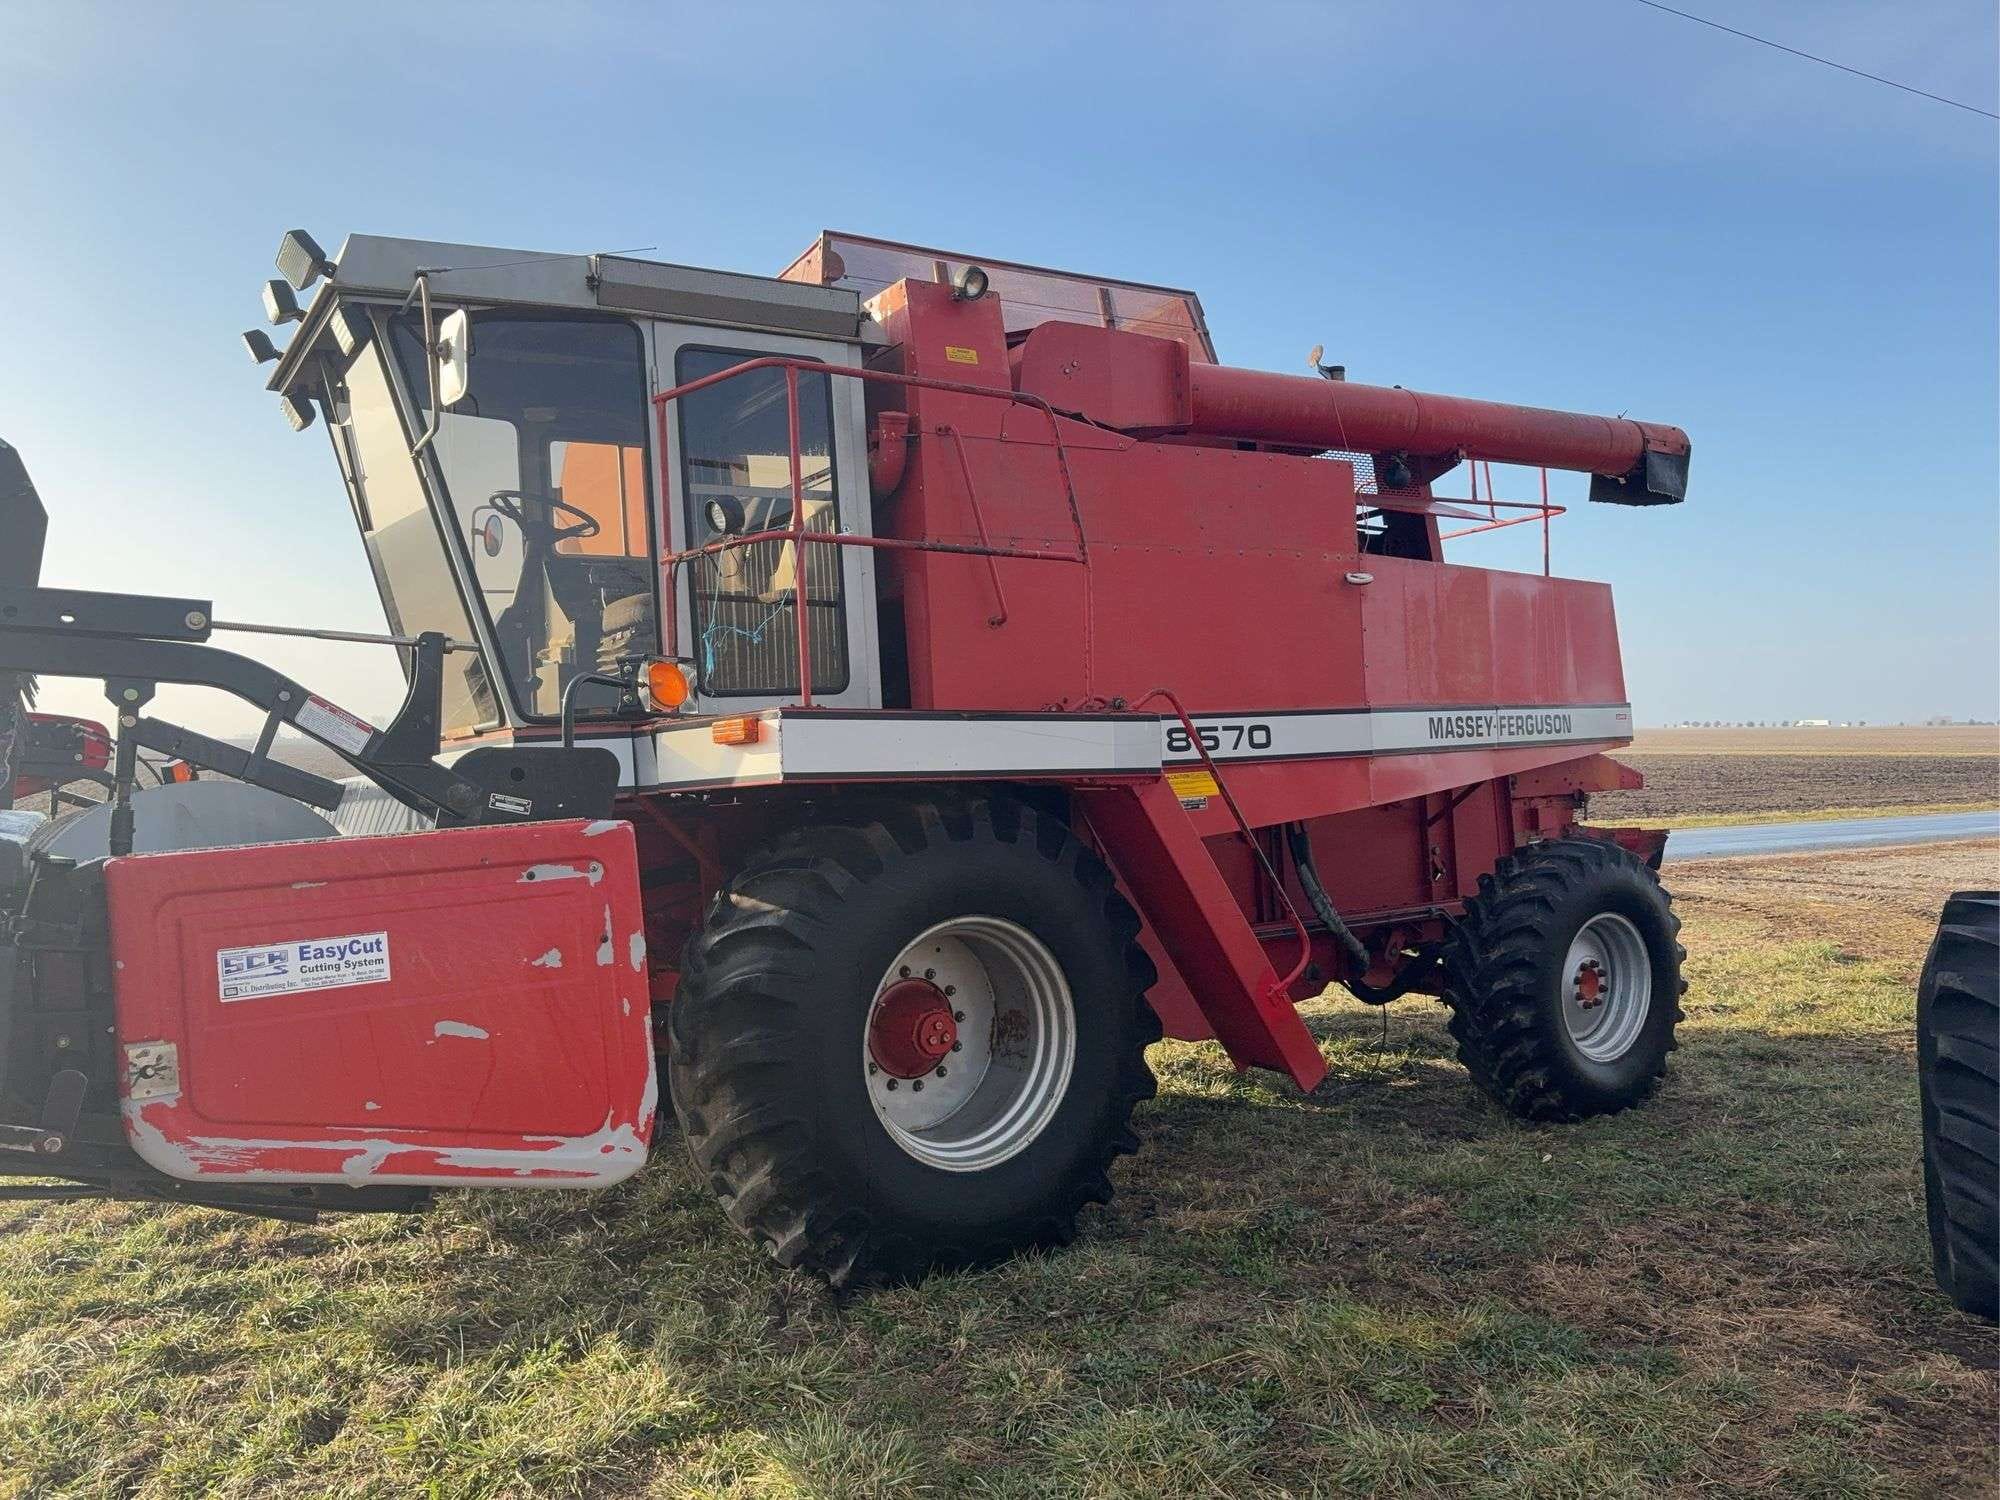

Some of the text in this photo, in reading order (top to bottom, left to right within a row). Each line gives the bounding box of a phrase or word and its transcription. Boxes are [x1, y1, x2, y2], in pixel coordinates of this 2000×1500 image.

[1166, 724, 1272, 752] 8570
[1428, 714, 1572, 739] MASSEY-FERGUSON
[298, 937, 383, 961] EasyCut
[300, 957, 384, 974] Cutting System
